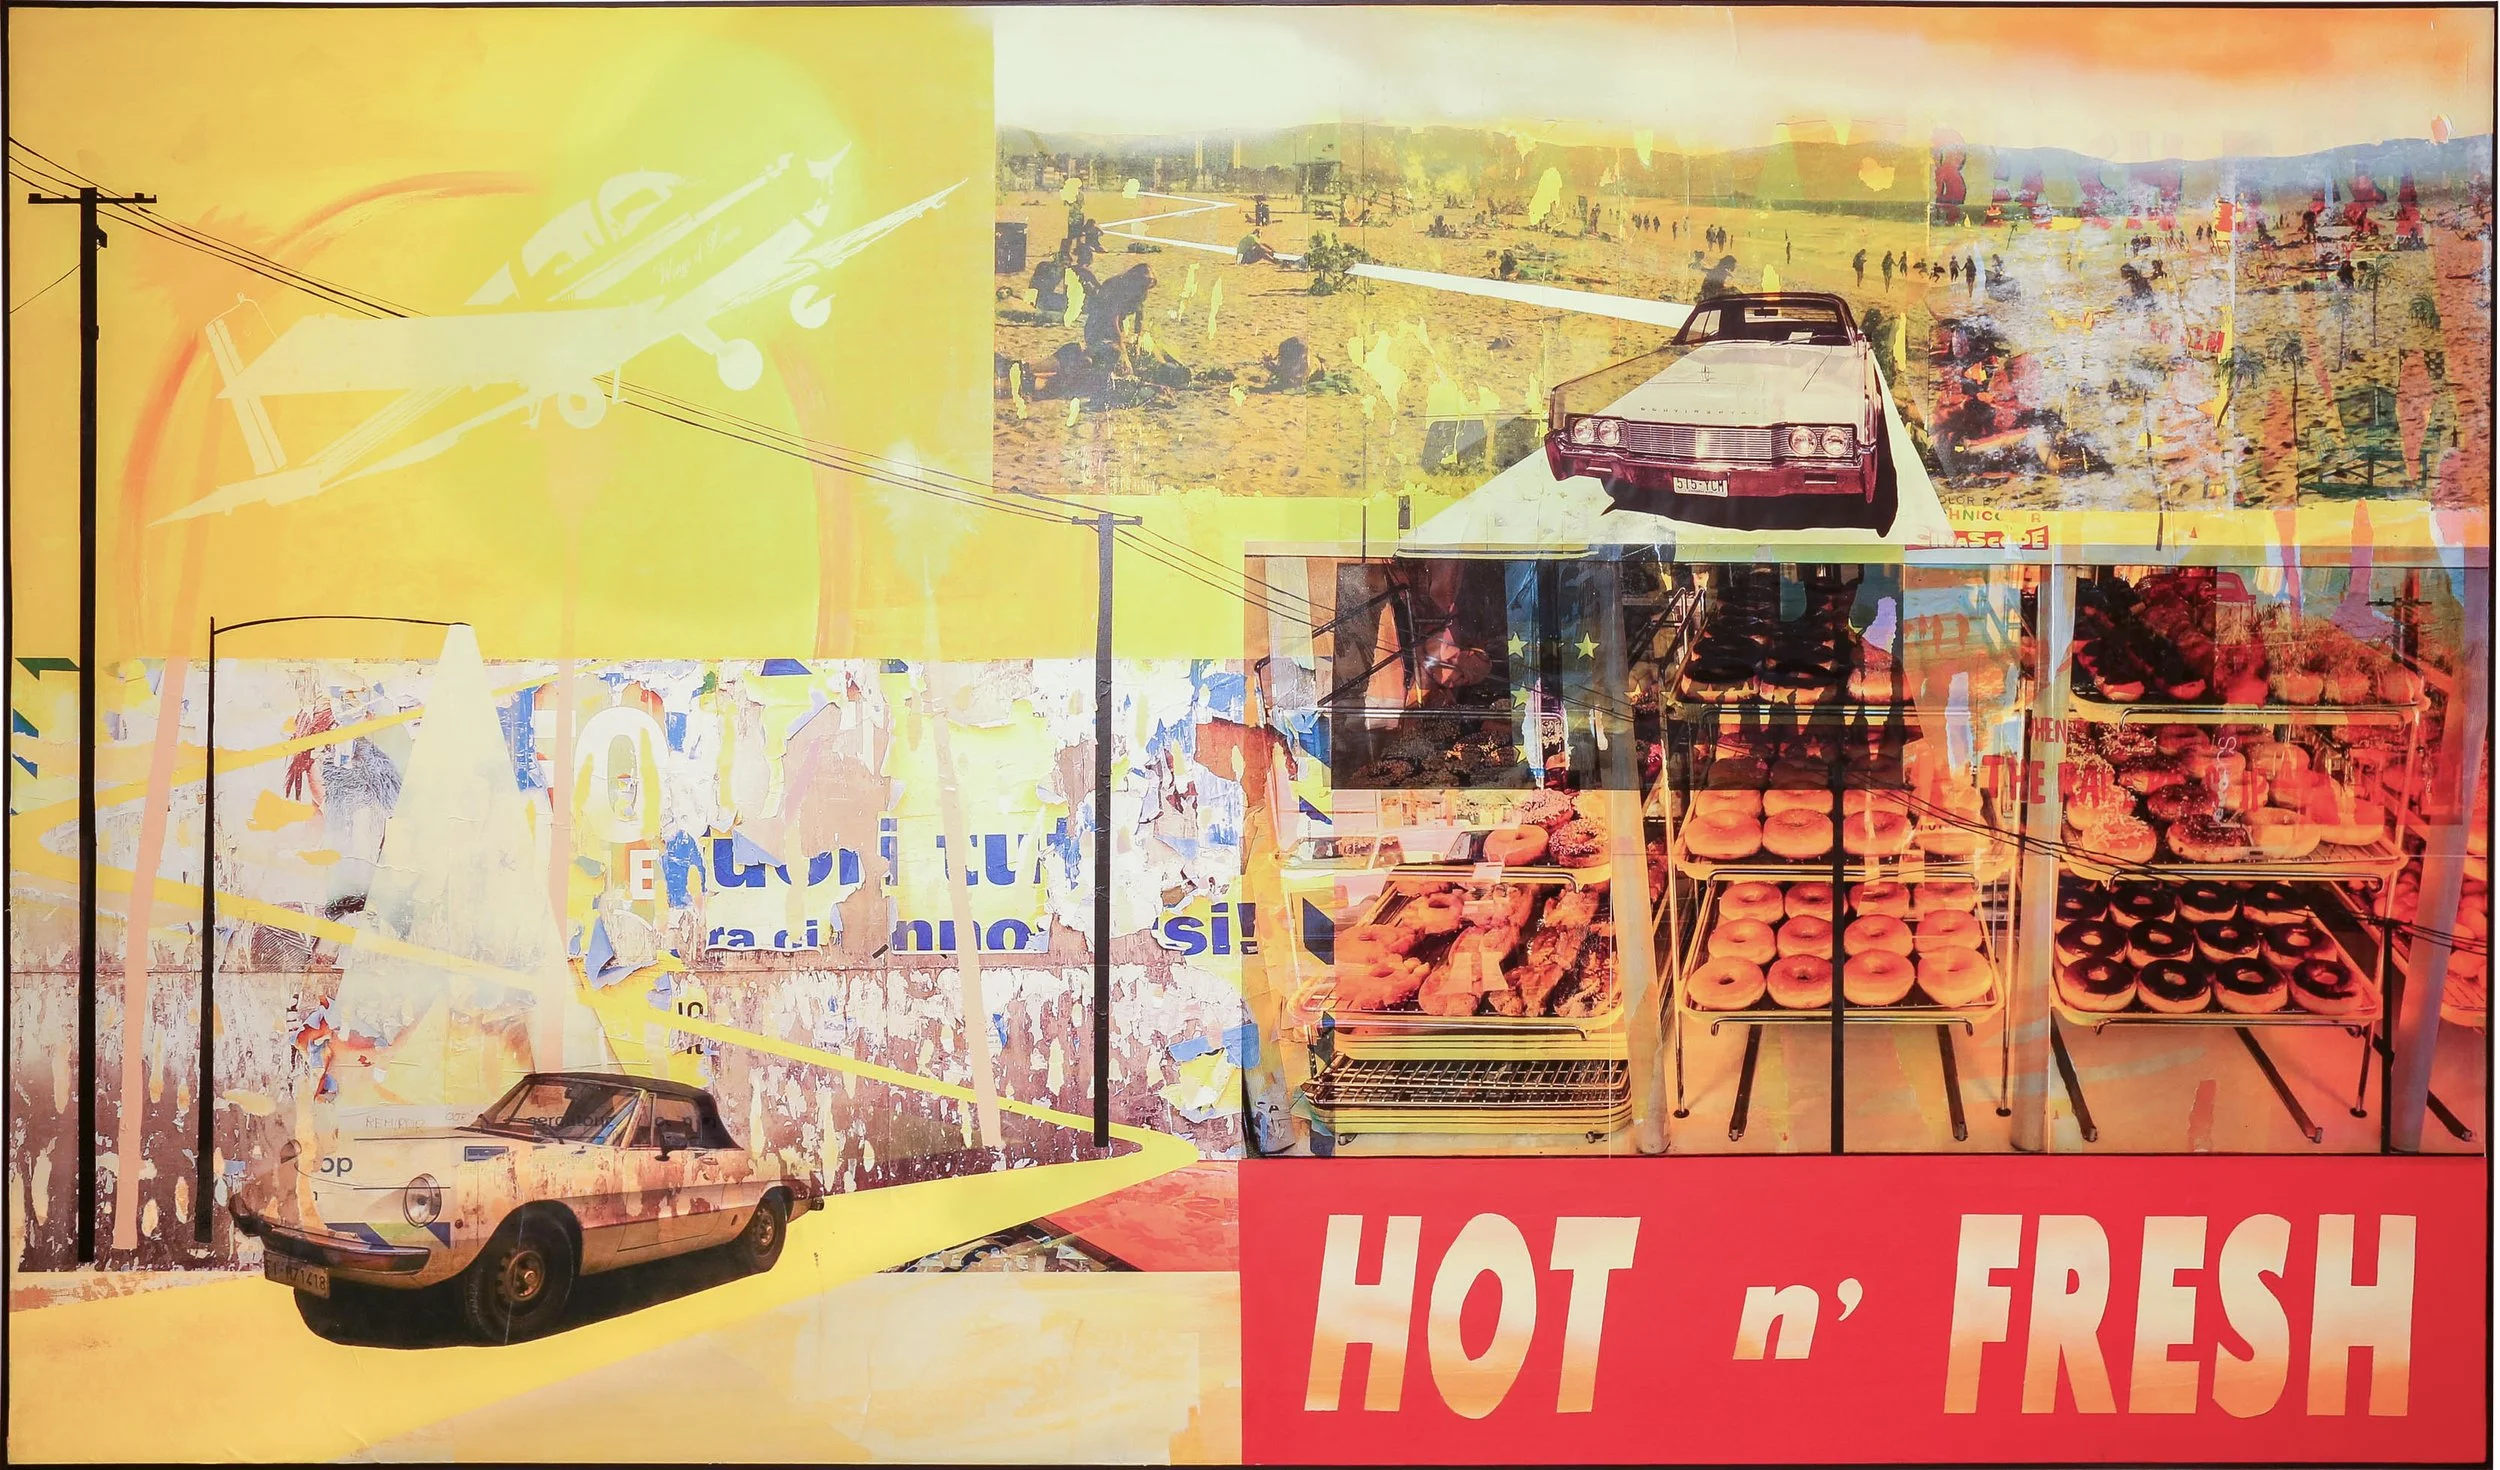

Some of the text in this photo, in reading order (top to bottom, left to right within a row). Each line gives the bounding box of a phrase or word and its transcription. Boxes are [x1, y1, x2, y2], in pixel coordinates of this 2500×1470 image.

[1940, 495, 1975, 505] OLOR
[1304, 1212, 1641, 1419] HOT
[1943, 1213, 2417, 1418] FRESH
